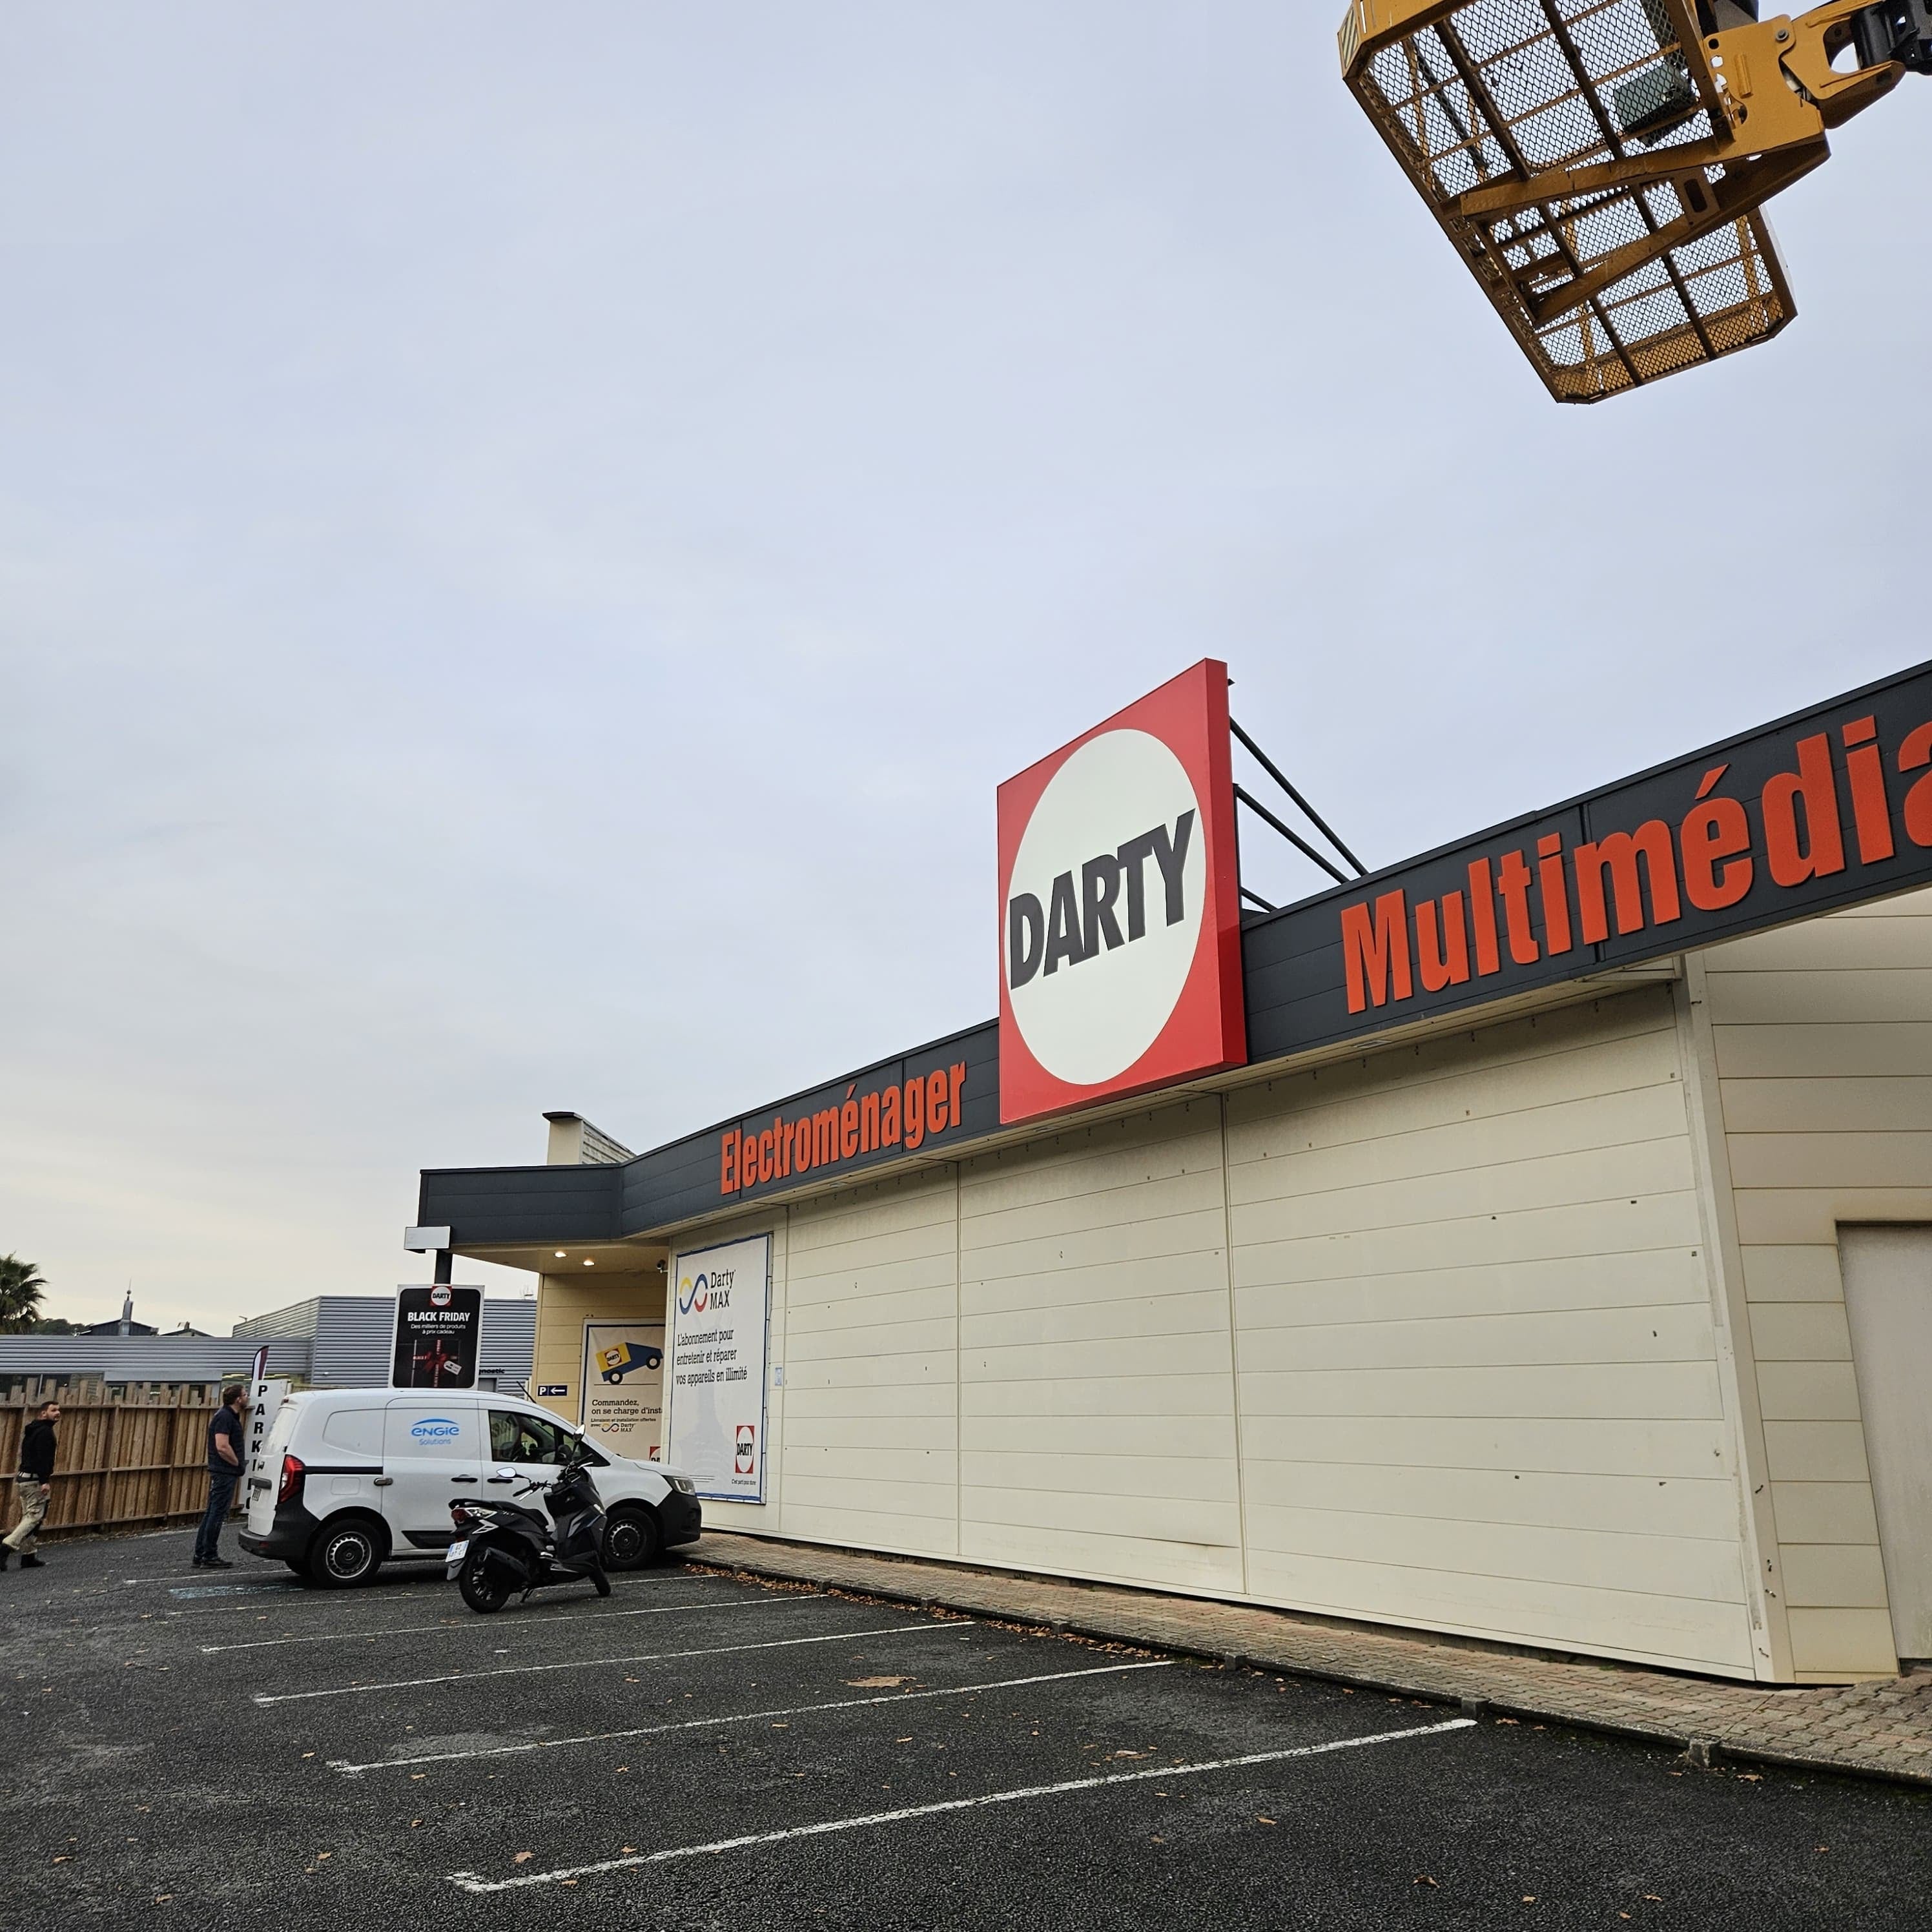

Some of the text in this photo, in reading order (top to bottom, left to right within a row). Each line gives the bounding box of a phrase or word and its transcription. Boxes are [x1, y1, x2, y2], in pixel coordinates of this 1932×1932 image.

[1009, 807, 1197, 991] DARTY
[721, 1061, 966, 1195] Electroménager
[711, 1269, 734, 1289] Darty
[710, 1290, 730, 1310] MAX
[407, 1311, 470, 1322] BLACK FRIDAY
[677, 1330, 734, 1346] L'abonnement pour
[607, 1353, 620, 1362] DARTY
[677, 1348, 737, 1365] entretenir et réparer
[676, 1366, 748, 1387] vos appareils en illimité
[539, 1387, 546, 1395] P
[613, 1407, 639, 1416] charge
[245, 1384, 268, 1510] PARKI
[737, 1443, 754, 1455] DARTY
